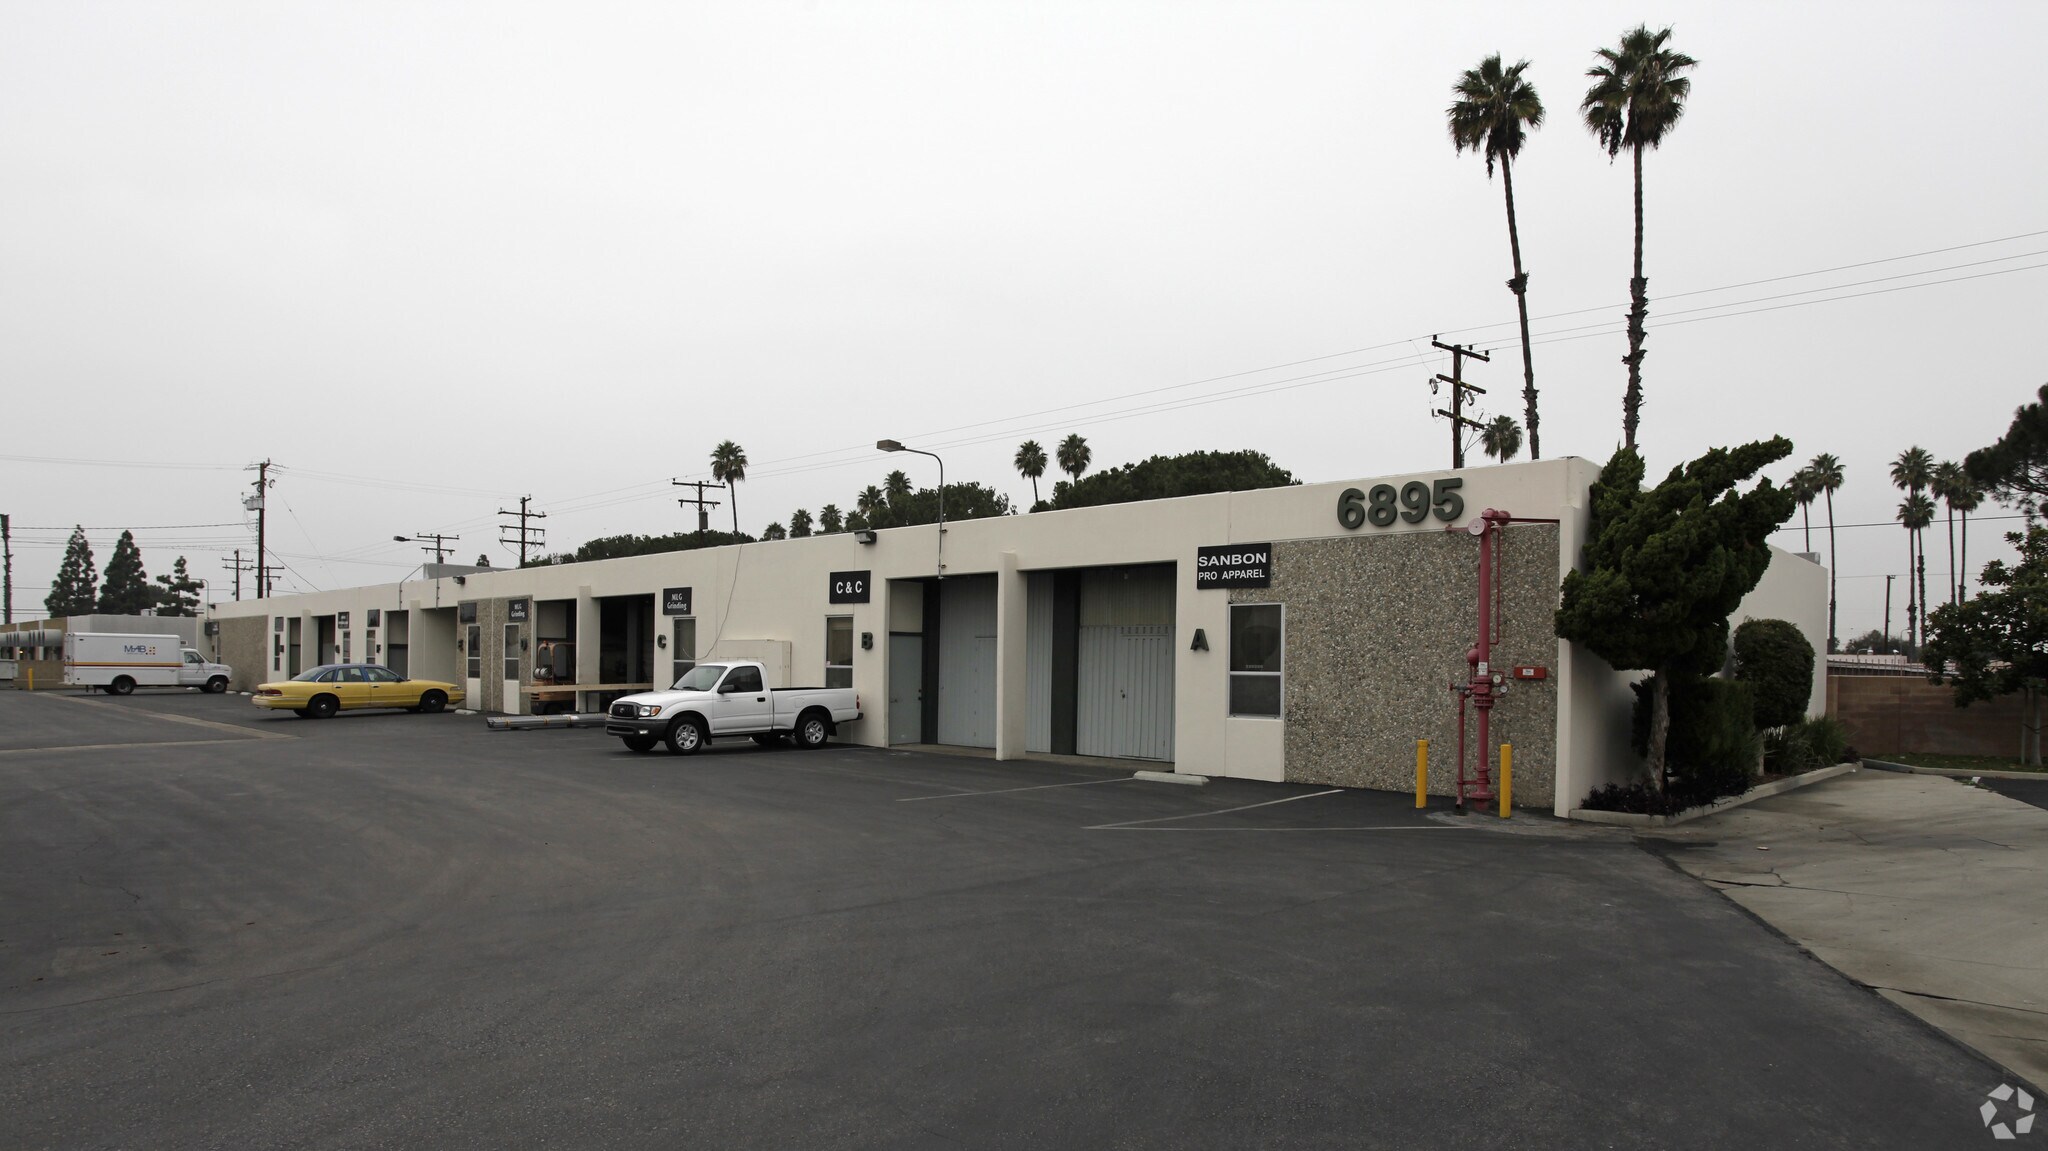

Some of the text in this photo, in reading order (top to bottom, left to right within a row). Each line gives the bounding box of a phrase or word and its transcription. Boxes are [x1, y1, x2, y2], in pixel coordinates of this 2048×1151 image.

[1337, 478, 1464, 529] 6895
[1199, 553, 1266, 567] SANBON
[1199, 569, 1265, 580] PRO APPAREL
[836, 580, 863, 594] C & C
[667, 602, 687, 611] Grinding
[657, 634, 667, 649] C
[861, 632, 873, 651] B
[1190, 629, 1209, 651] A
